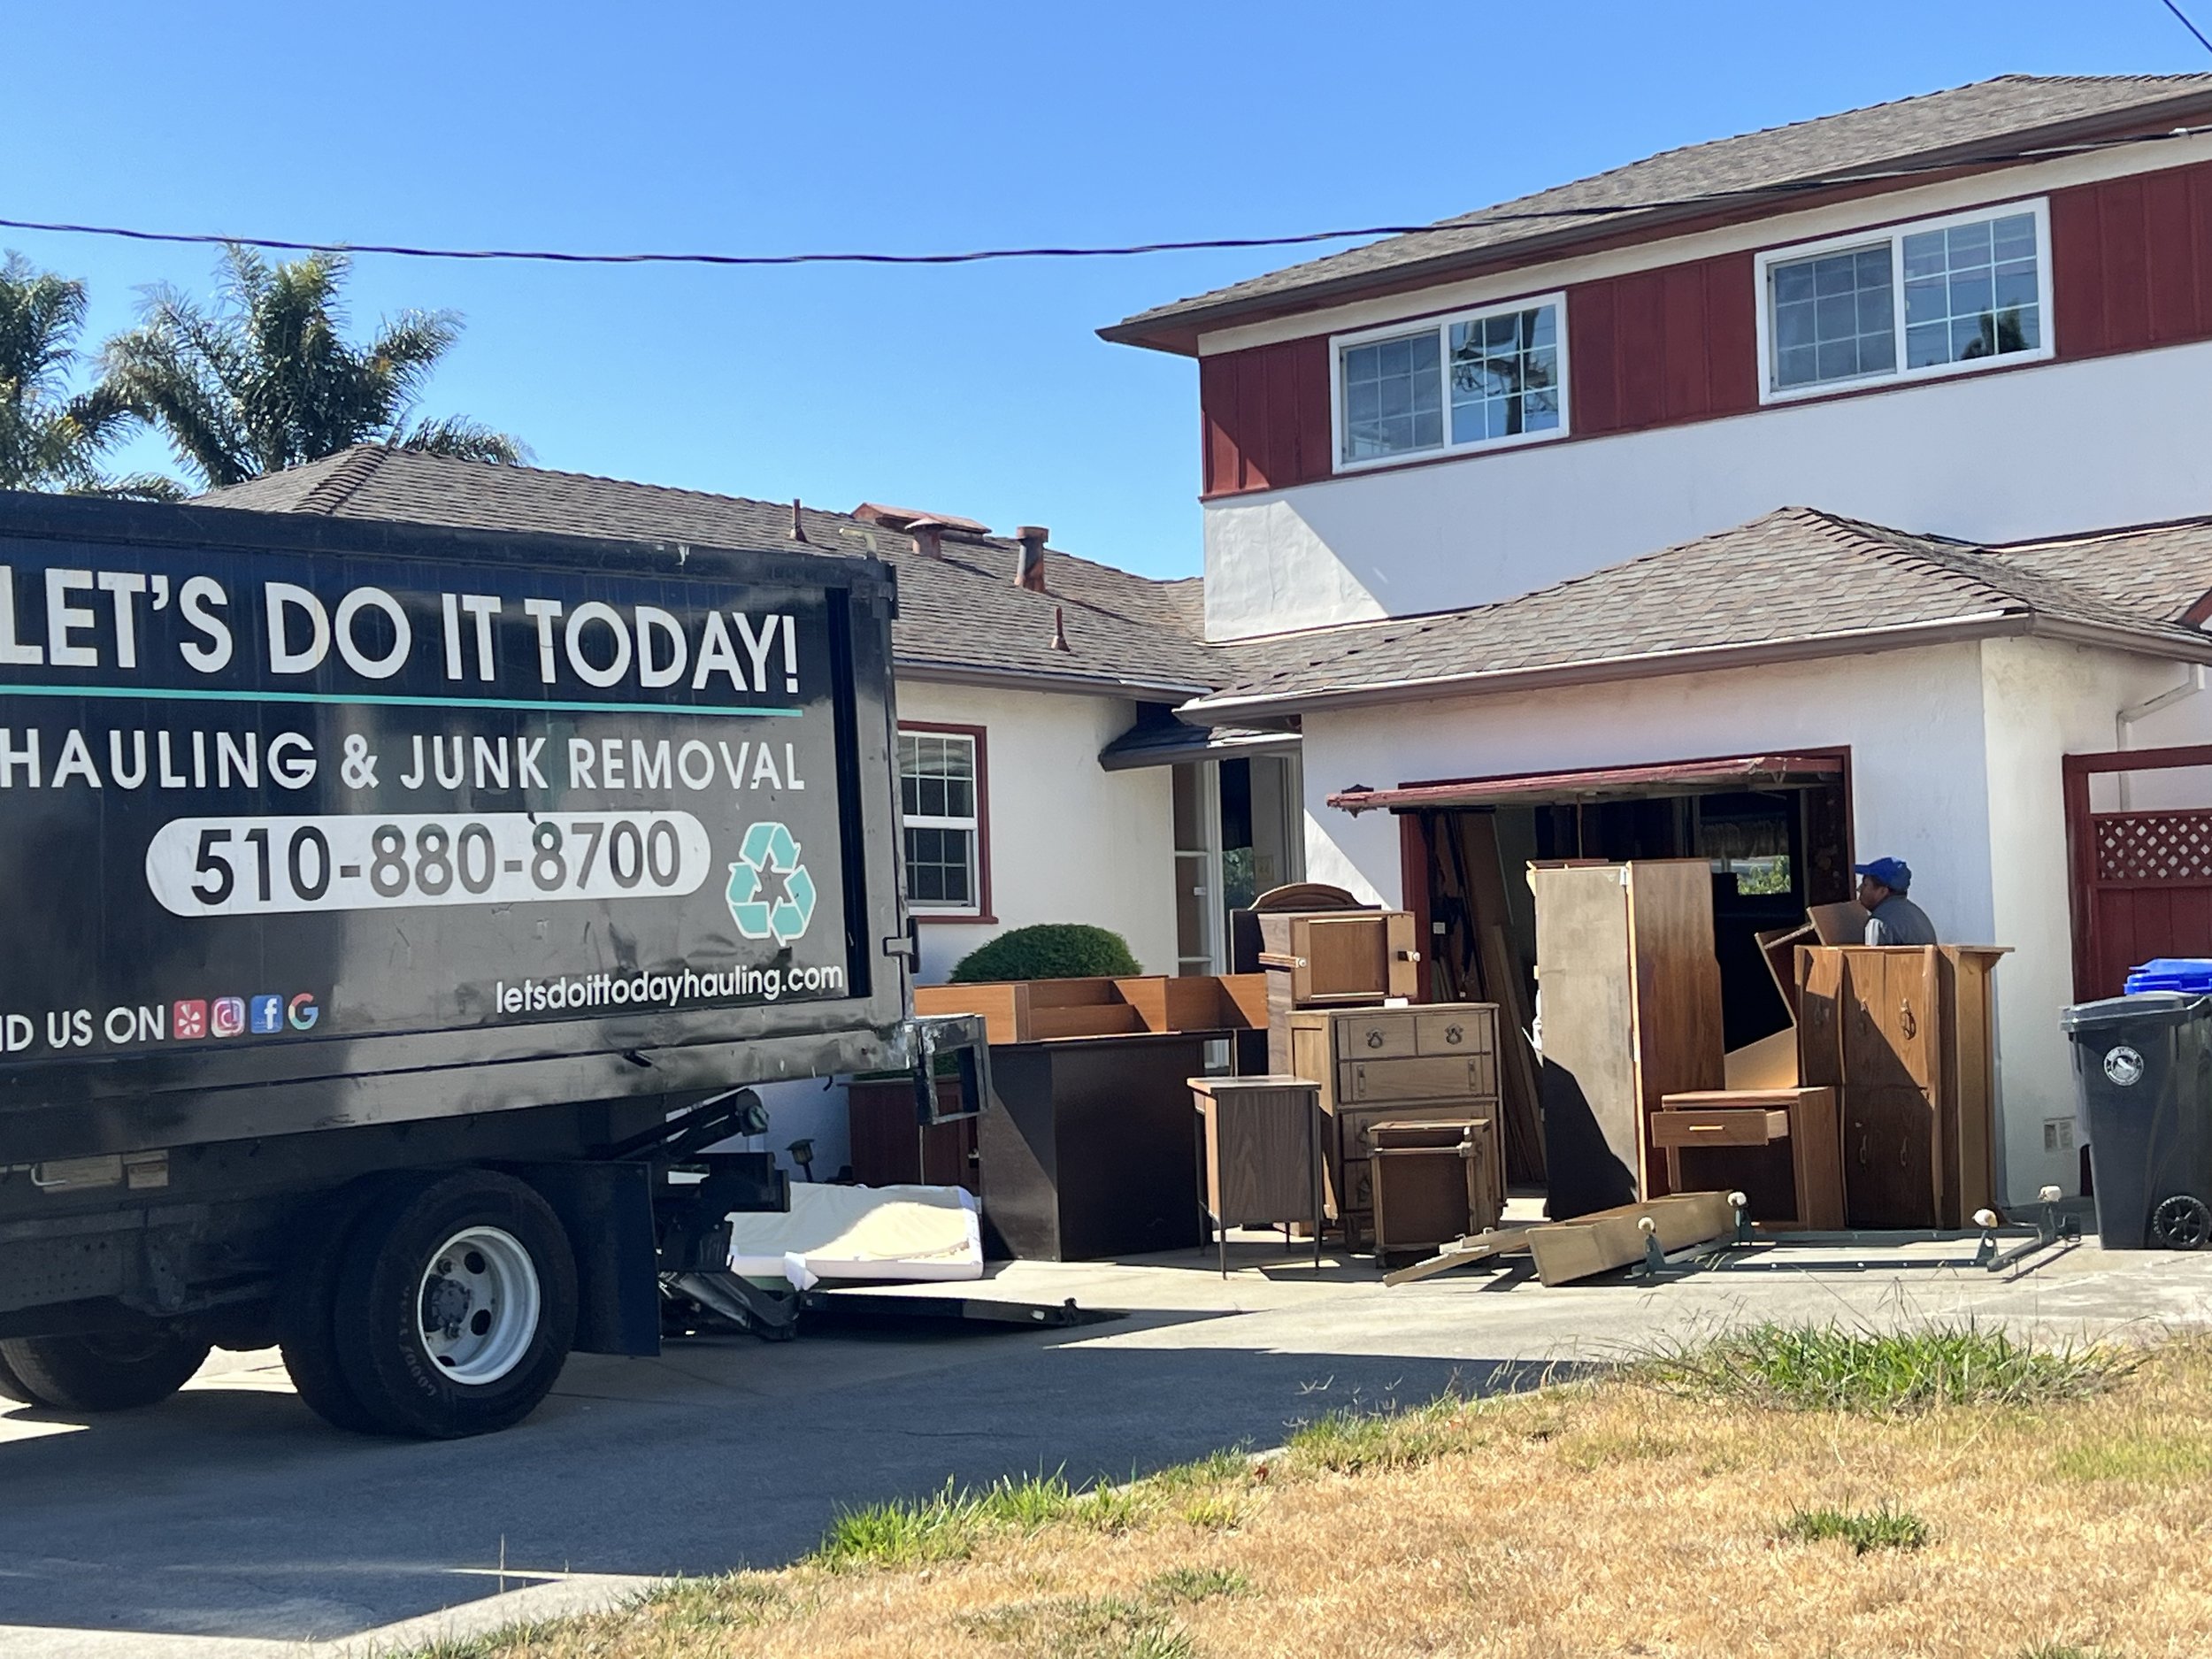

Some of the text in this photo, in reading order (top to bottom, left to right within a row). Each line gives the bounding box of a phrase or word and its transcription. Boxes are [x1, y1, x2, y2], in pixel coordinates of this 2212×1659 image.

[0, 565, 799, 694] LET'S DO IT TODAY!
[0, 727, 805, 790] HAULING & JUNK REMOVAL
[190, 819, 680, 906] 510-880-8700
[495, 964, 843, 1014] letsdoittodayhauling.com
[0, 1014, 35, 1052] D
[47, 1009, 94, 1048] US
[104, 1005, 165, 1043] ON
